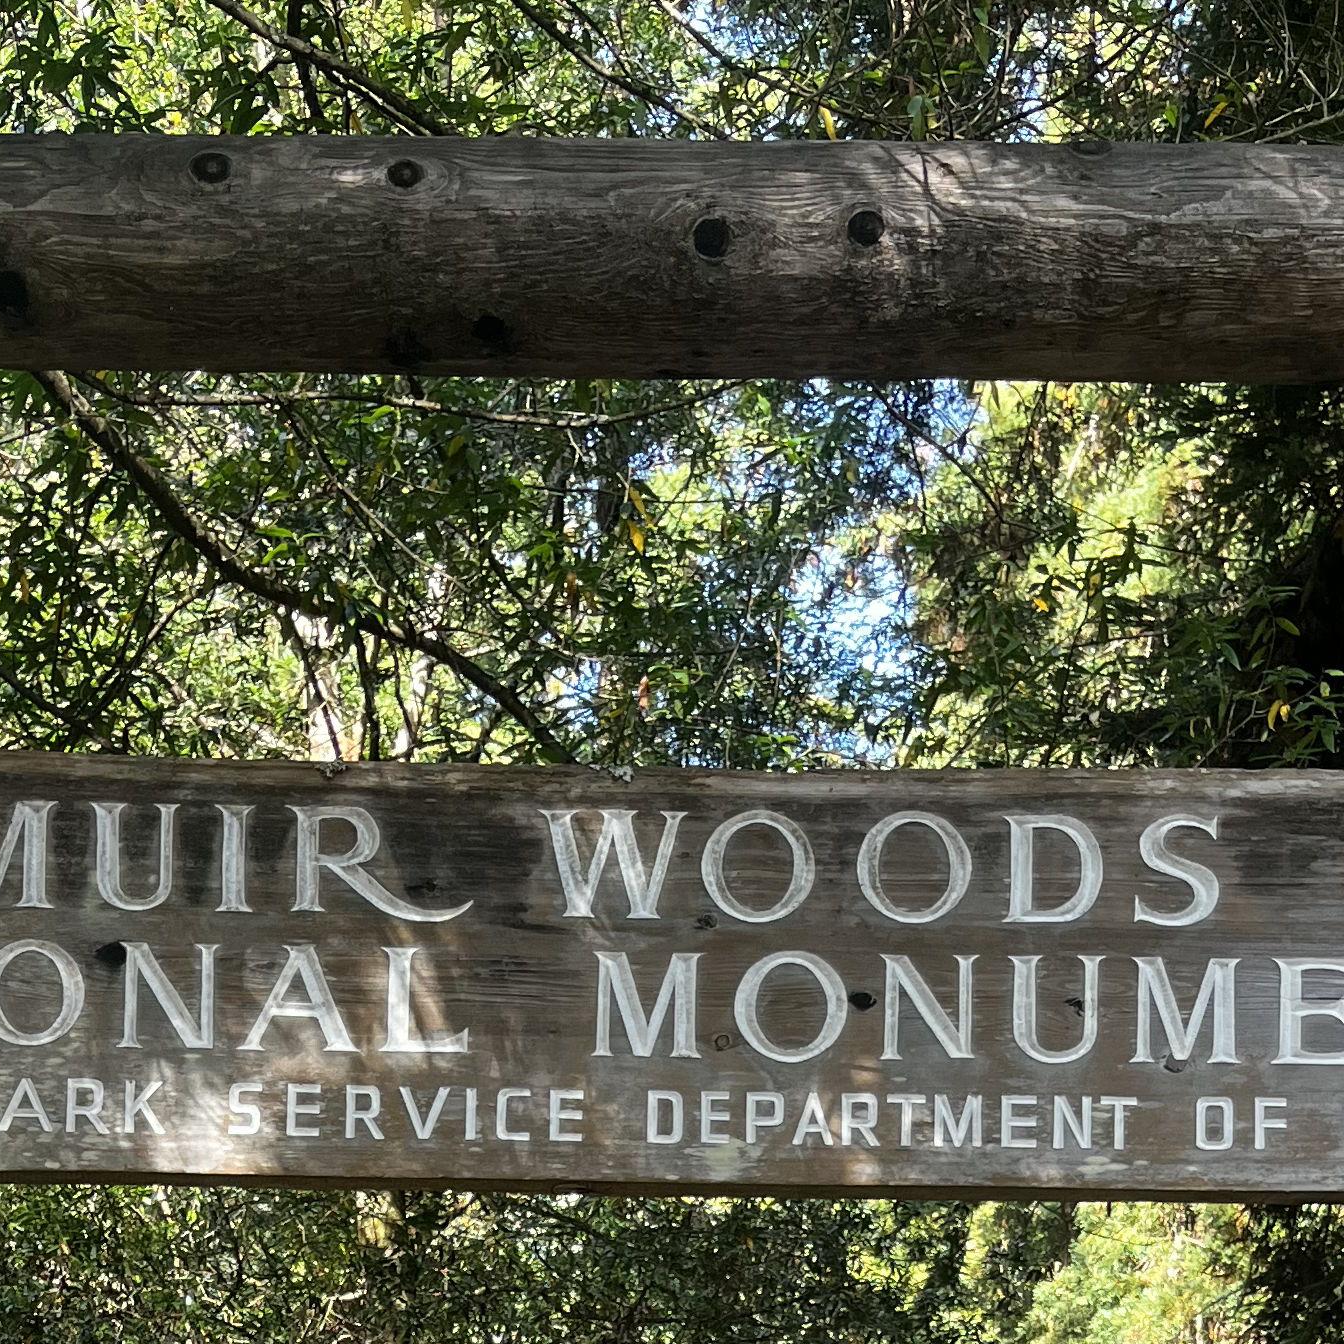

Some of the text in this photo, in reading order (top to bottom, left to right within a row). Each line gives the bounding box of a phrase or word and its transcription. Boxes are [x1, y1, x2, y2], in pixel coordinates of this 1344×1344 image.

[539, 809, 1219, 926] WOODS
[228, 1083, 584, 1142] SERVICE
[646, 1090, 1138, 1150] DEPARTMENT
[1196, 1097, 1288, 1150] OF
